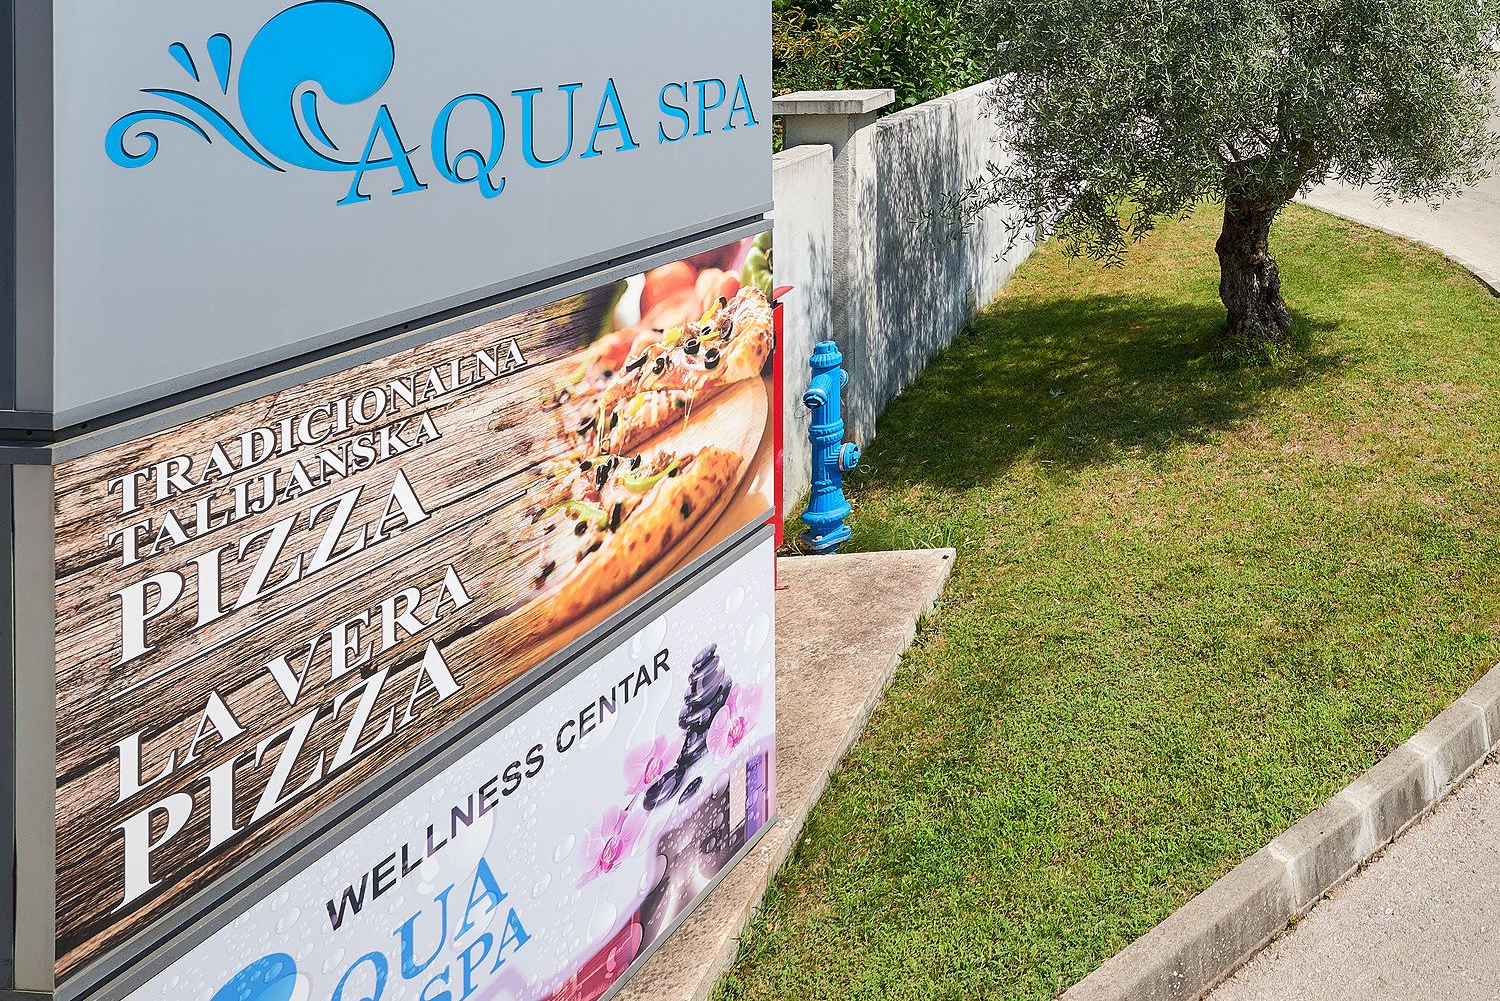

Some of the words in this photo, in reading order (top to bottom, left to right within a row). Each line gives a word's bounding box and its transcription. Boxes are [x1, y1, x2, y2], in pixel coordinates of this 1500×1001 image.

[336, 77, 640, 207] AQUA
[657, 74, 760, 145] SPA
[107, 410, 442, 571] TALIJANSKA
[108, 337, 529, 518] TRADICIONALNA
[110, 468, 432, 669] PIZZA
[109, 690, 247, 810] LA
[264, 564, 474, 707] VERA
[110, 639, 466, 916] PIZZA
[325, 744, 545, 932] WELLNESS
[556, 648, 672, 753] CENTAR
